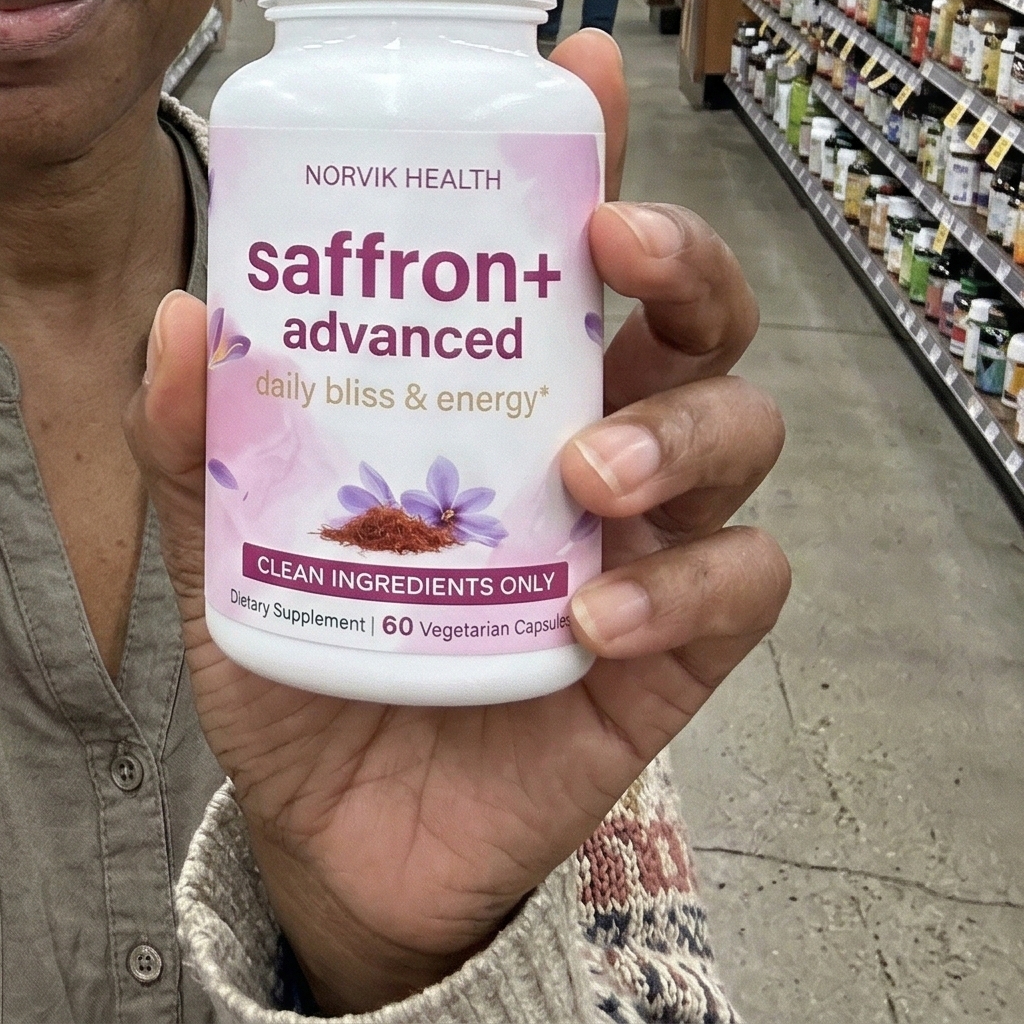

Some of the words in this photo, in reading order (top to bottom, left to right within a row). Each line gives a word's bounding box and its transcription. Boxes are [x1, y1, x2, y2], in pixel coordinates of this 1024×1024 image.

[305, 164, 398, 188] NORVIK
[406, 166, 502, 190] HEALTH
[247, 230, 561, 302] saffron+
[282, 310, 523, 359] advanced
[255, 369, 317, 408] daily
[325, 375, 395, 409] bliss
[404, 383, 428, 410] &
[257, 555, 324, 586] CLEAN
[332, 571, 494, 597] INGREDIENTS
[500, 571, 556, 595] ONLY
[230, 588, 271, 618] Dietary
[273, 601, 366, 634] Supplement
[382, 614, 415, 637] 60
[420, 613, 511, 643] Vegetarian
[514, 612, 571, 637] Capsules
